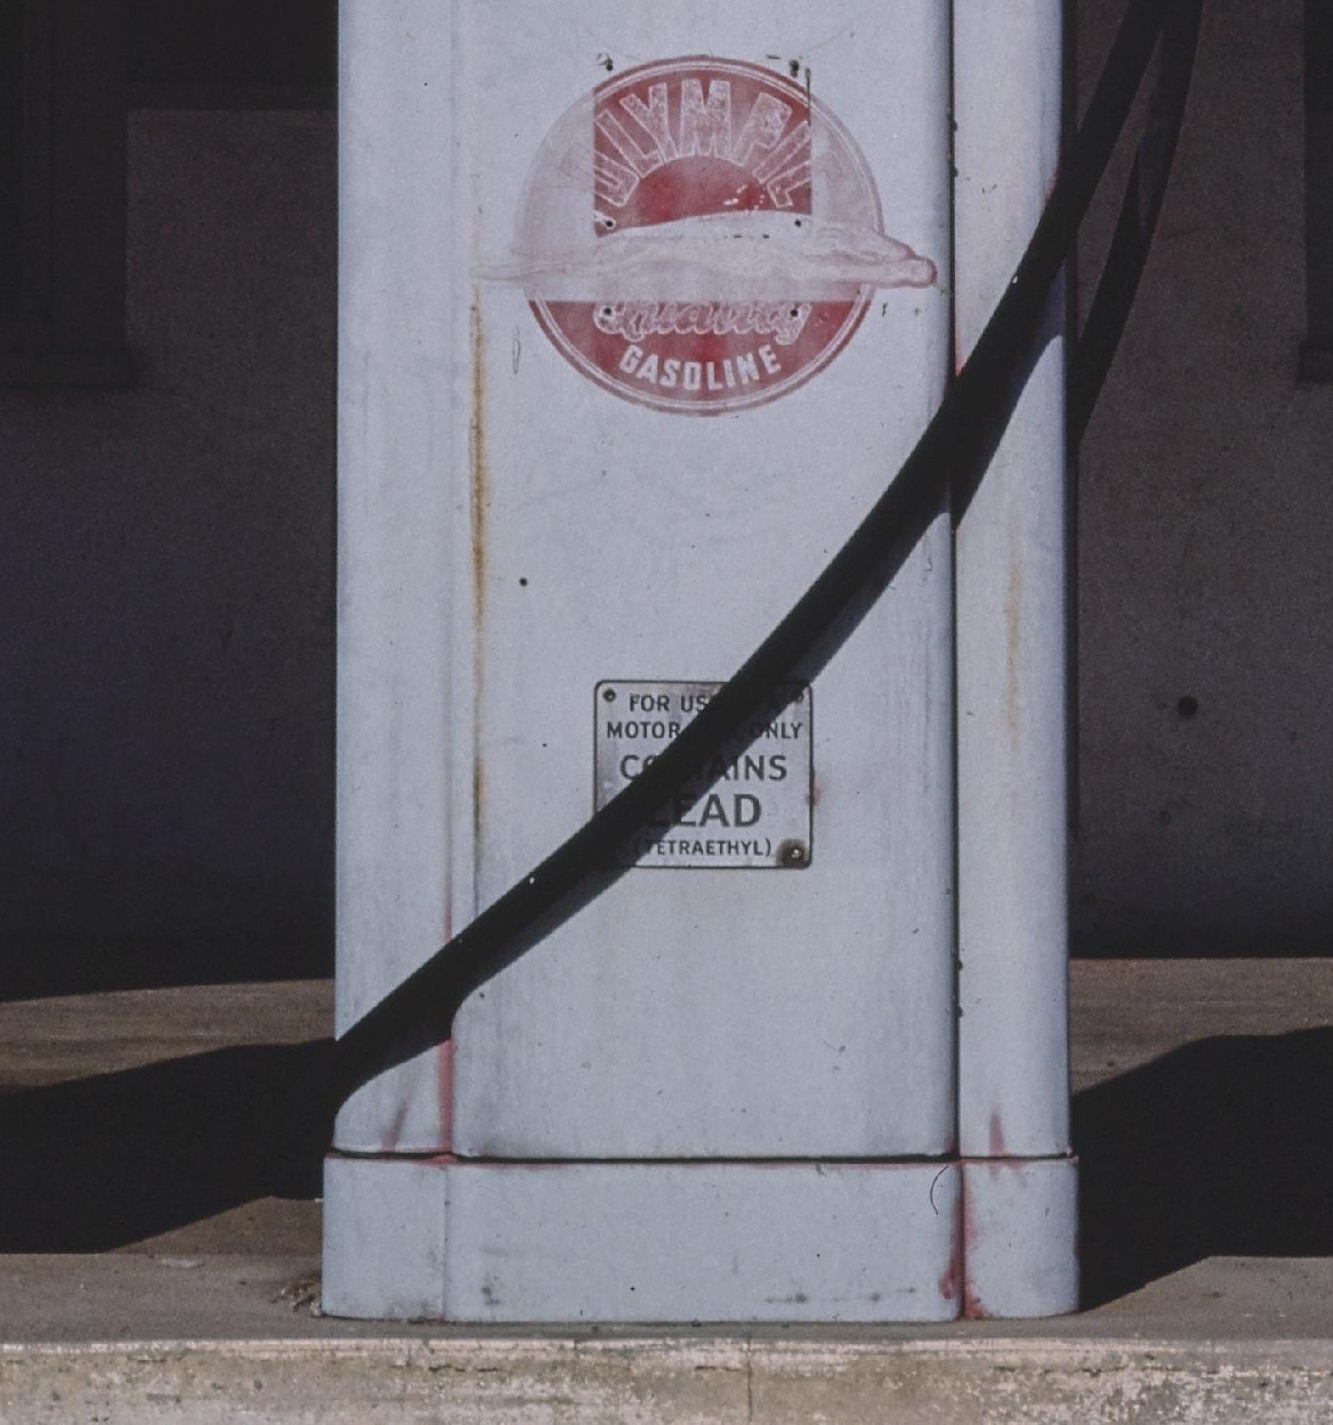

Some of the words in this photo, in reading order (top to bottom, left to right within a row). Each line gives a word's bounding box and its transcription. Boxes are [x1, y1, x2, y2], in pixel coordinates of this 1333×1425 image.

[617, 342, 784, 391] GASOLINE
[629, 693, 670, 712] FOR
[680, 694, 712, 712] US
[607, 722, 681, 739] MOTOR
